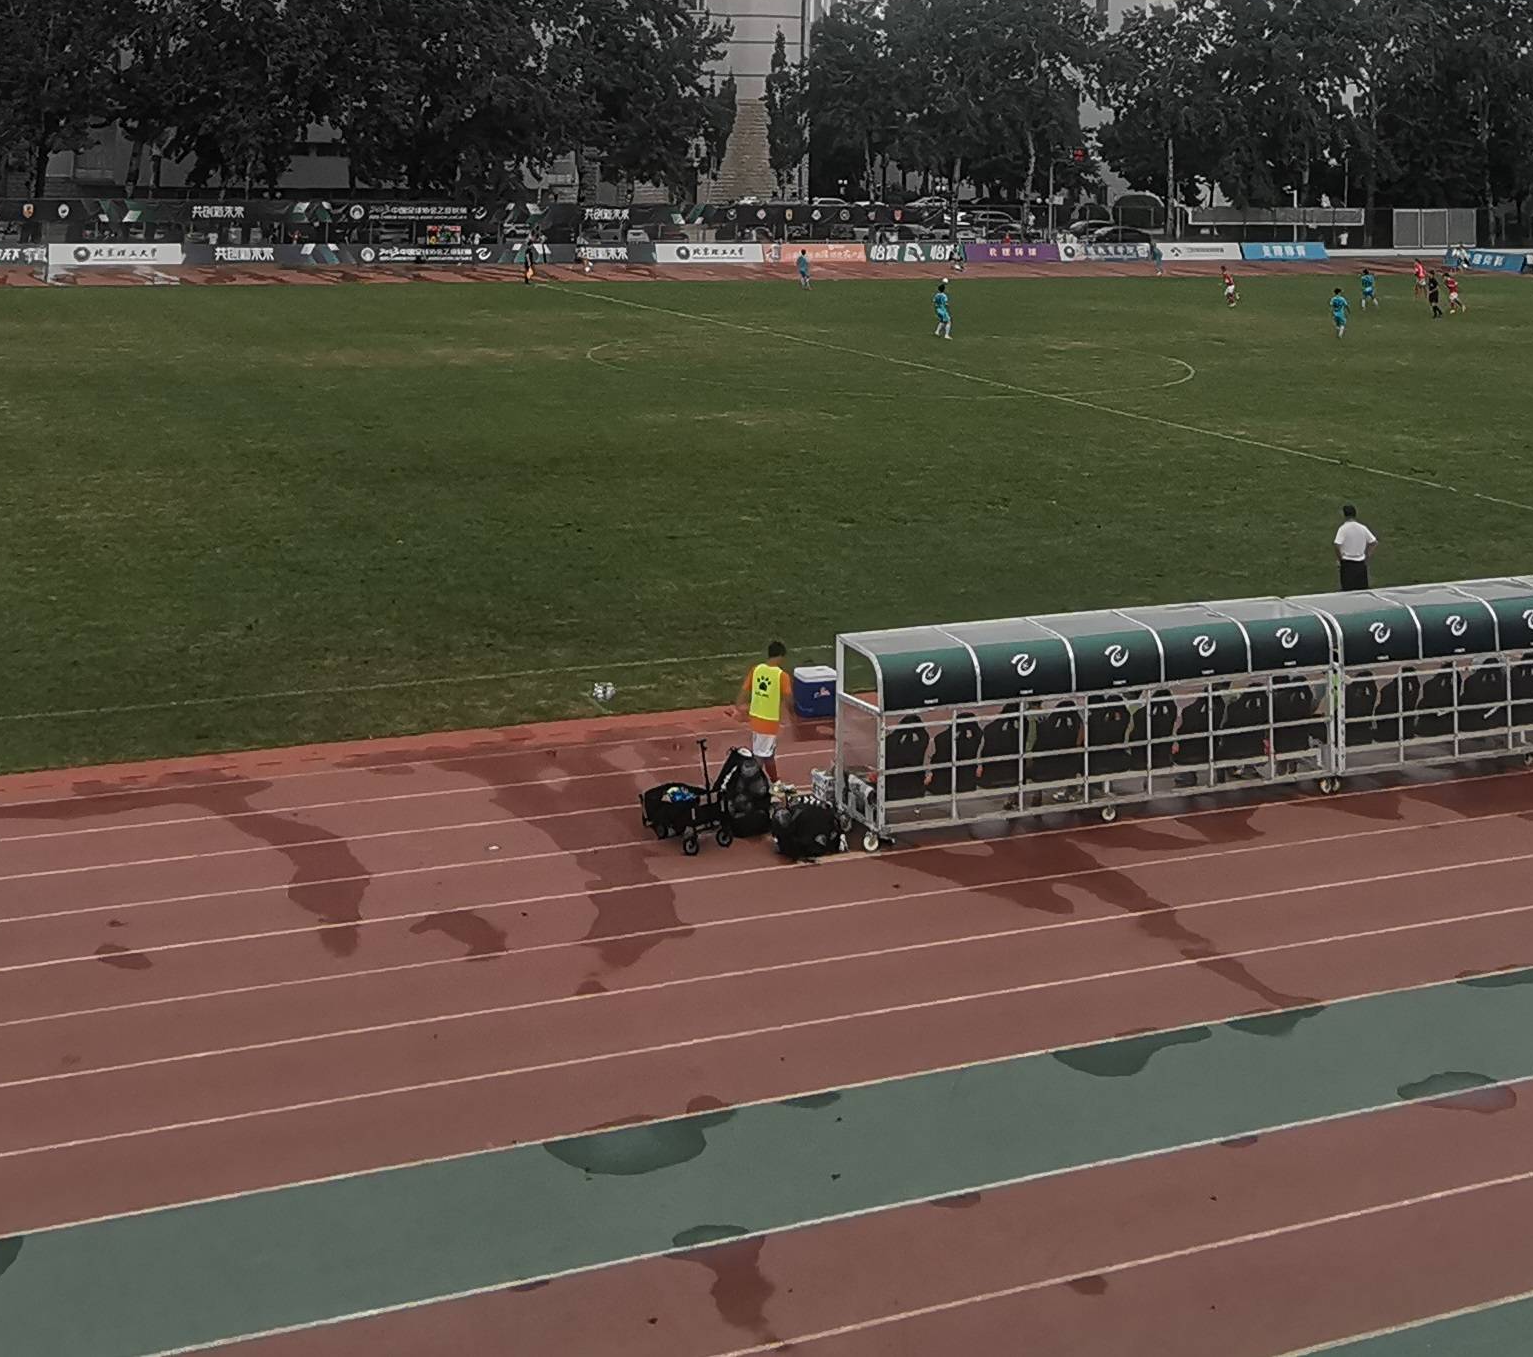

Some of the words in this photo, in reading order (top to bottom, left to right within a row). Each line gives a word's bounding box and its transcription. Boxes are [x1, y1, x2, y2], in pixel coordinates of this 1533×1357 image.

[94, 247, 157, 259] 北京理工大学
